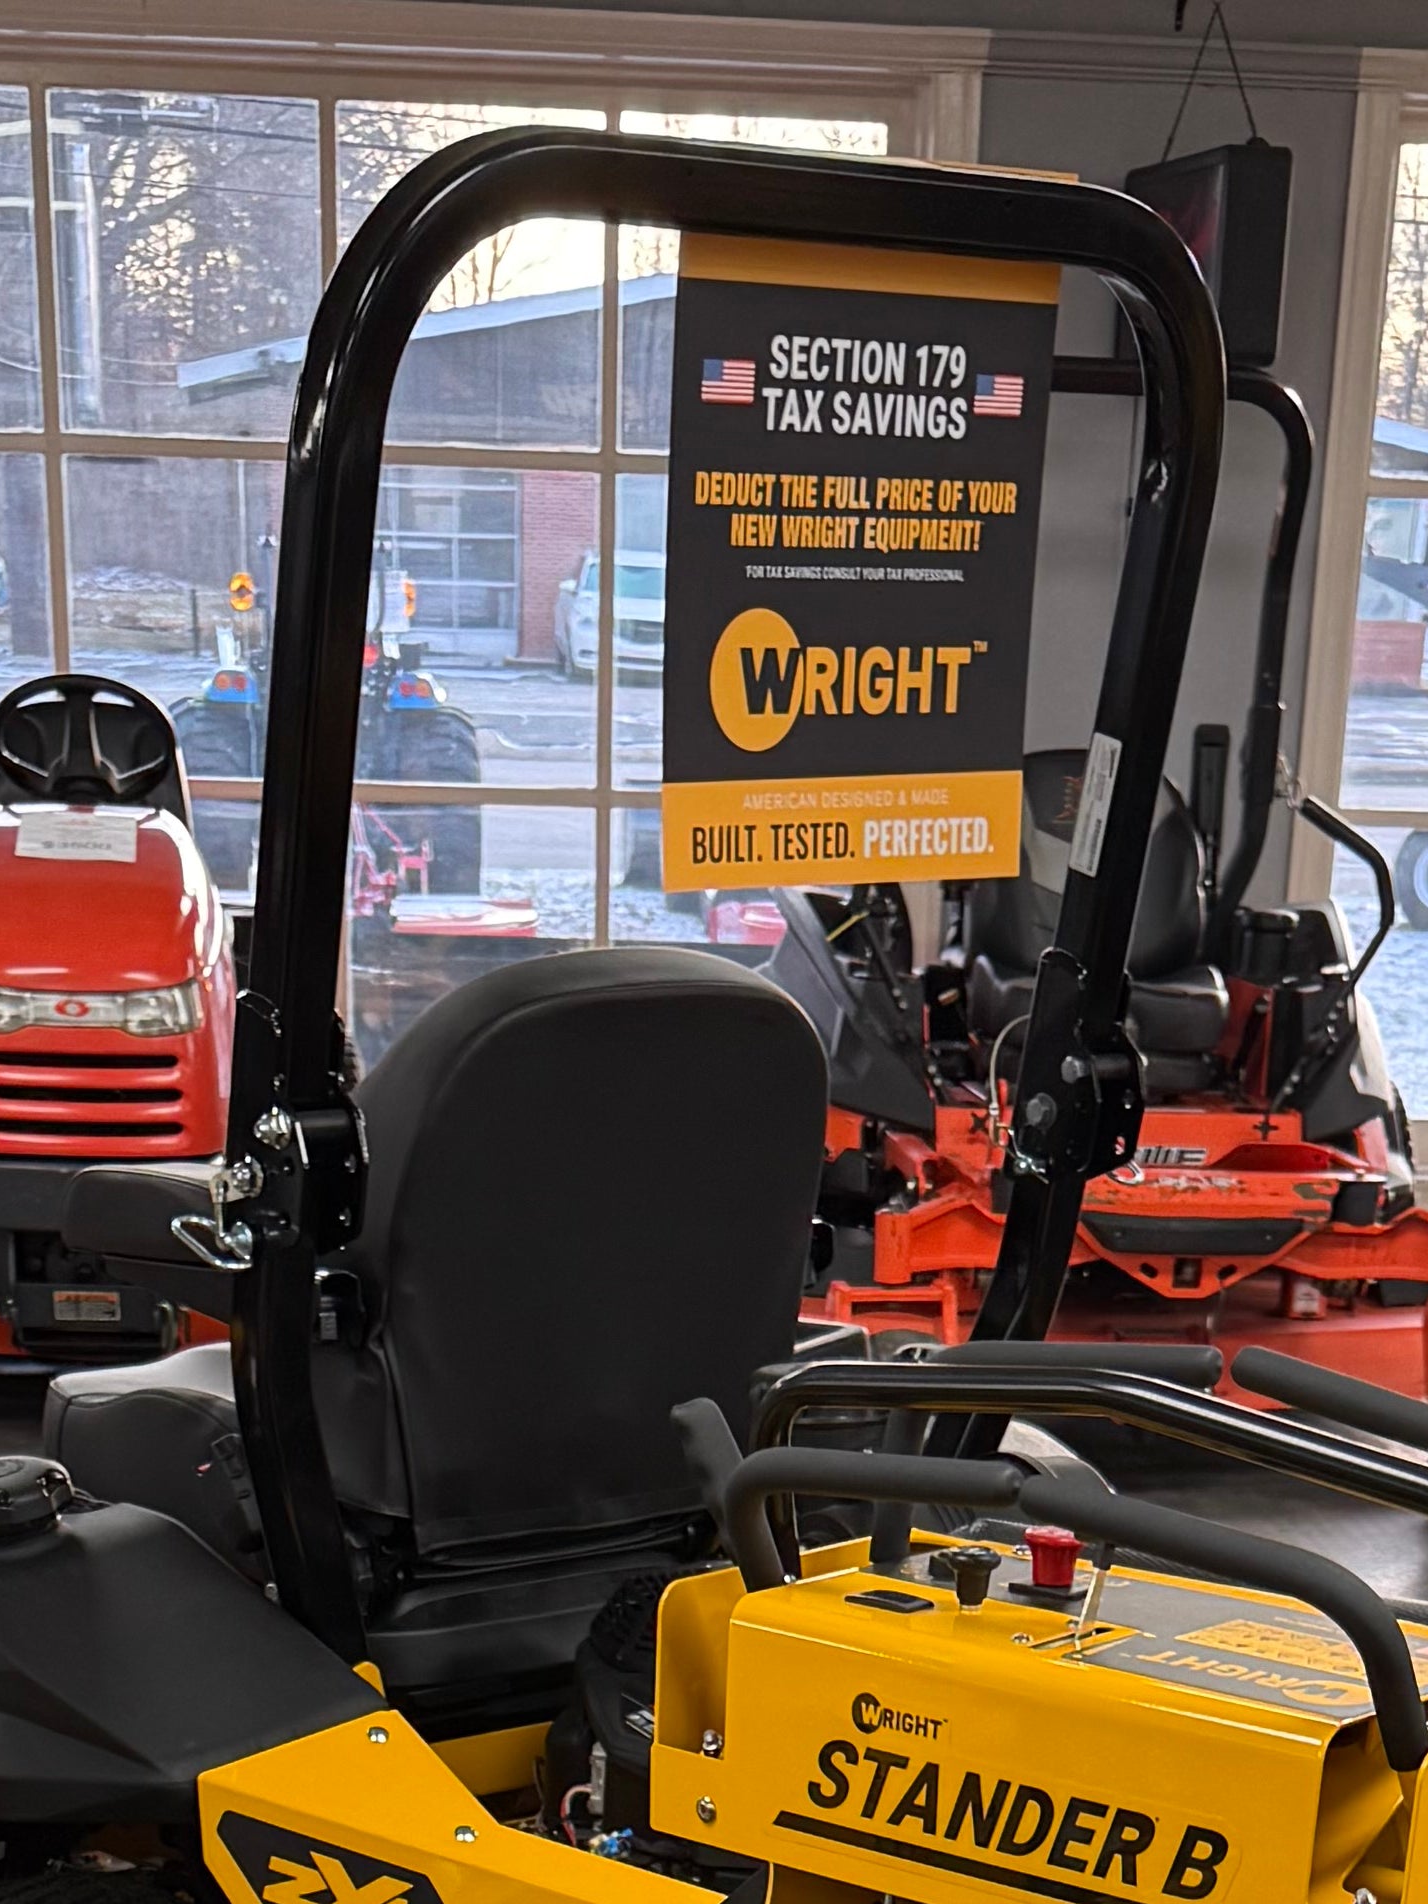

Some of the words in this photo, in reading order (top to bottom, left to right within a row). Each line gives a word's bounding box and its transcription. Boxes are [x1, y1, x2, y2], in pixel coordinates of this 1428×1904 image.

[770, 333, 908, 388] SECTION
[916, 344, 967, 389] 179
[762, 387, 823, 433] TAX
[832, 392, 967, 440] SAVINGS
[695, 471, 777, 507] DEDUCT
[781, 474, 819, 508] THE
[824, 476, 870, 510] FULL
[875, 478, 936, 511] PRICE
[940, 480, 964, 511] OF
[967, 481, 1017, 514] YOUR
[730, 513, 777, 547] NEW
[782, 515, 860, 549] WRIGHT
[863, 517, 984, 554] EQUIPMENT!
[766, 566, 782, 579] TAX
[784, 566, 822, 580] SAVINGS
[823, 566, 861, 580] CONSULT
[862, 567, 885, 581] YOUR
[886, 568, 903, 581] TAX
[903, 568, 965, 582] PROFESSIONAL
[740, 646, 972, 715] WRIGHT
[743, 792, 817, 810] AMERICAN
[820, 790, 892, 808] DESIGNED
[898, 791, 906, 807] &
[910, 788, 949, 806] MADE
[692, 823, 763, 864] BUILT.
[772, 820, 856, 861] TESTED.
[863, 816, 994, 859] PERFECTED.
[1137, 1650, 1346, 1701] WRIGHT
[858, 1700, 943, 1741] WRIGHT
[808, 1740, 1157, 1886] STANDER
[1162, 1825, 1229, 1901] B
